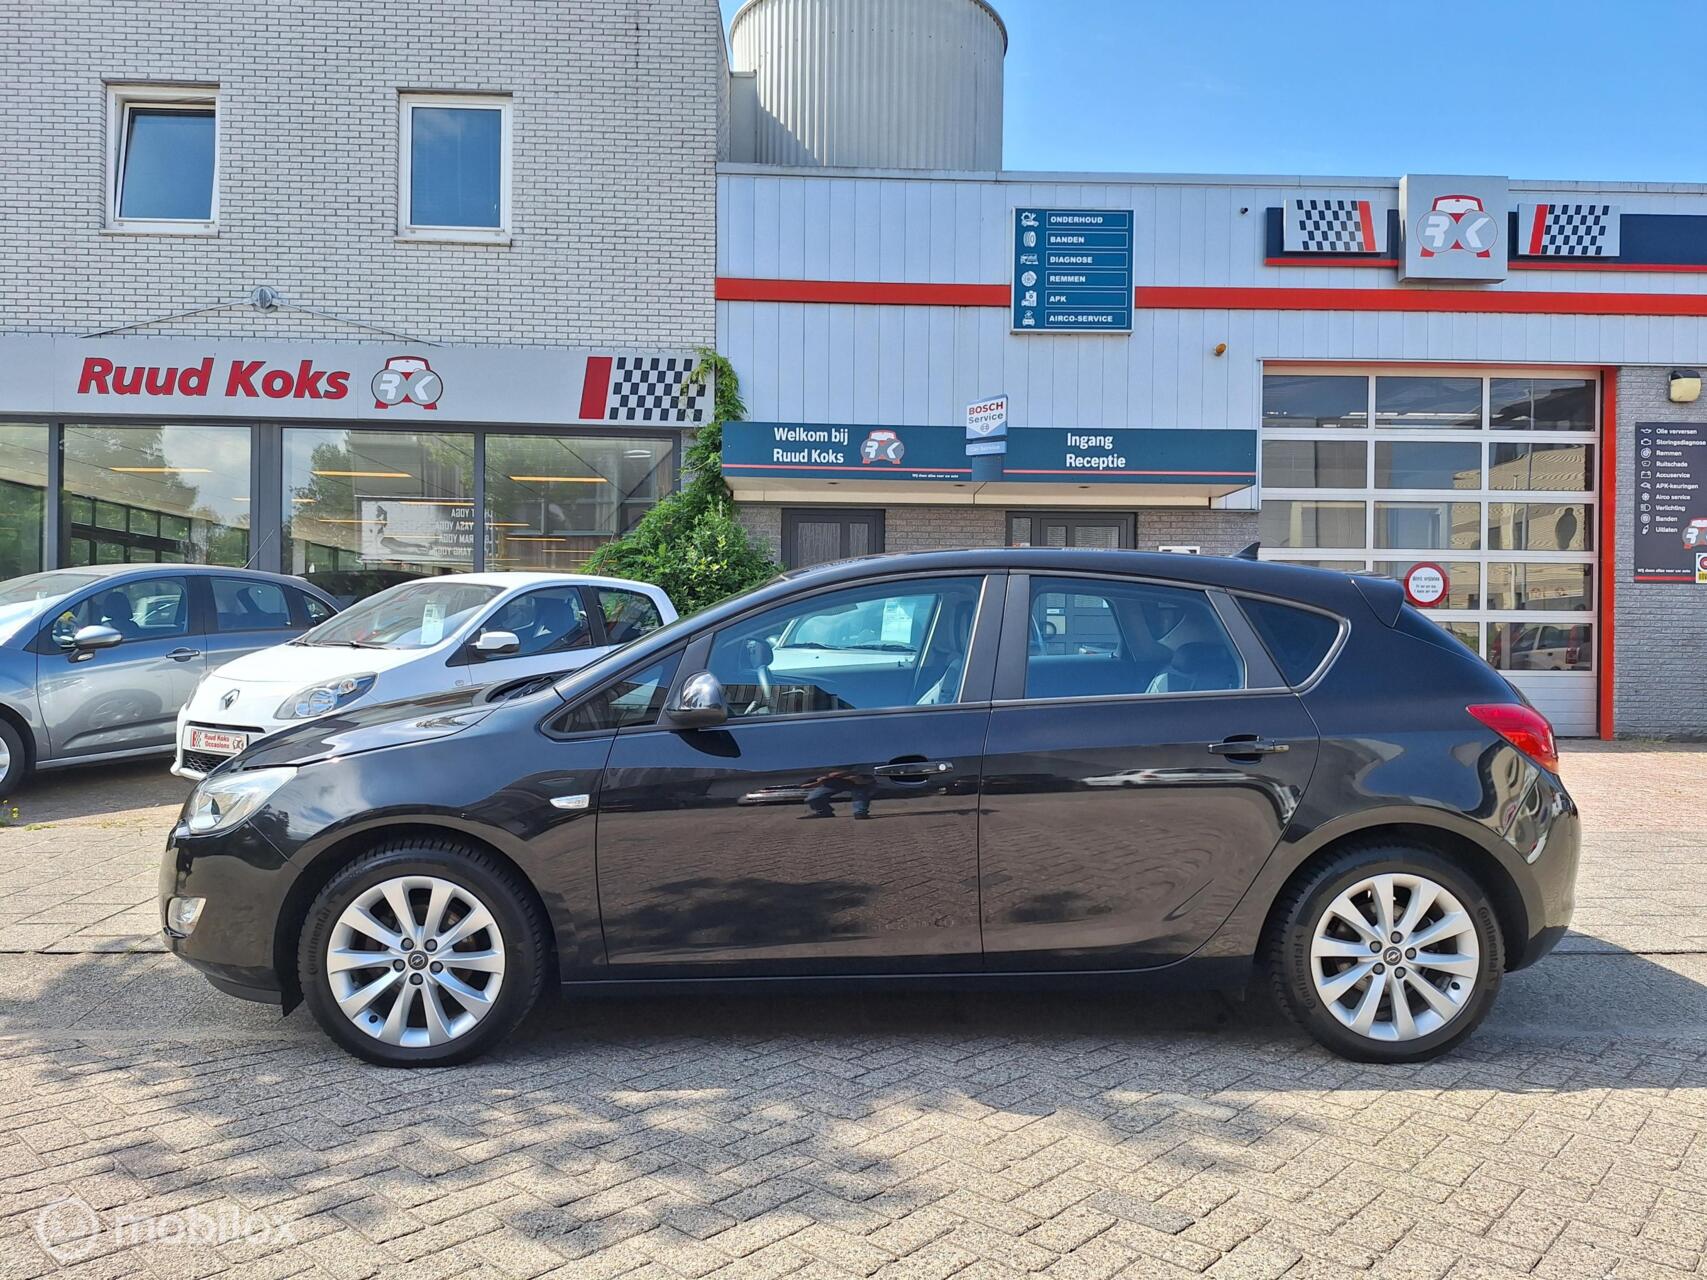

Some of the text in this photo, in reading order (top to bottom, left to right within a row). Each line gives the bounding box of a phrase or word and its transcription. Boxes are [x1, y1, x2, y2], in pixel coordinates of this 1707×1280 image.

[1050, 216, 1103, 224] ONDERHOUD
[1050, 256, 1093, 264] DIAGNOSE
[1049, 275, 1086, 283] REMMEN
[1049, 295, 1067, 303] APK
[77, 357, 350, 399] Ruud Koks
[968, 401, 1004, 415] BOSCH
[968, 413, 1004, 424] Service
[774, 427, 849, 445] Welkom bij
[1067, 432, 1113, 449] Ingang
[773, 448, 844, 463] Ruud Koks
[1066, 453, 1126, 470] Receptie
[1656, 482, 1699, 490] APK-keuringen
[1655, 504, 1686, 512] Verlichting
[1479, 905, 1500, 974] Continental
[1294, 943, 1316, 1010] Continental
